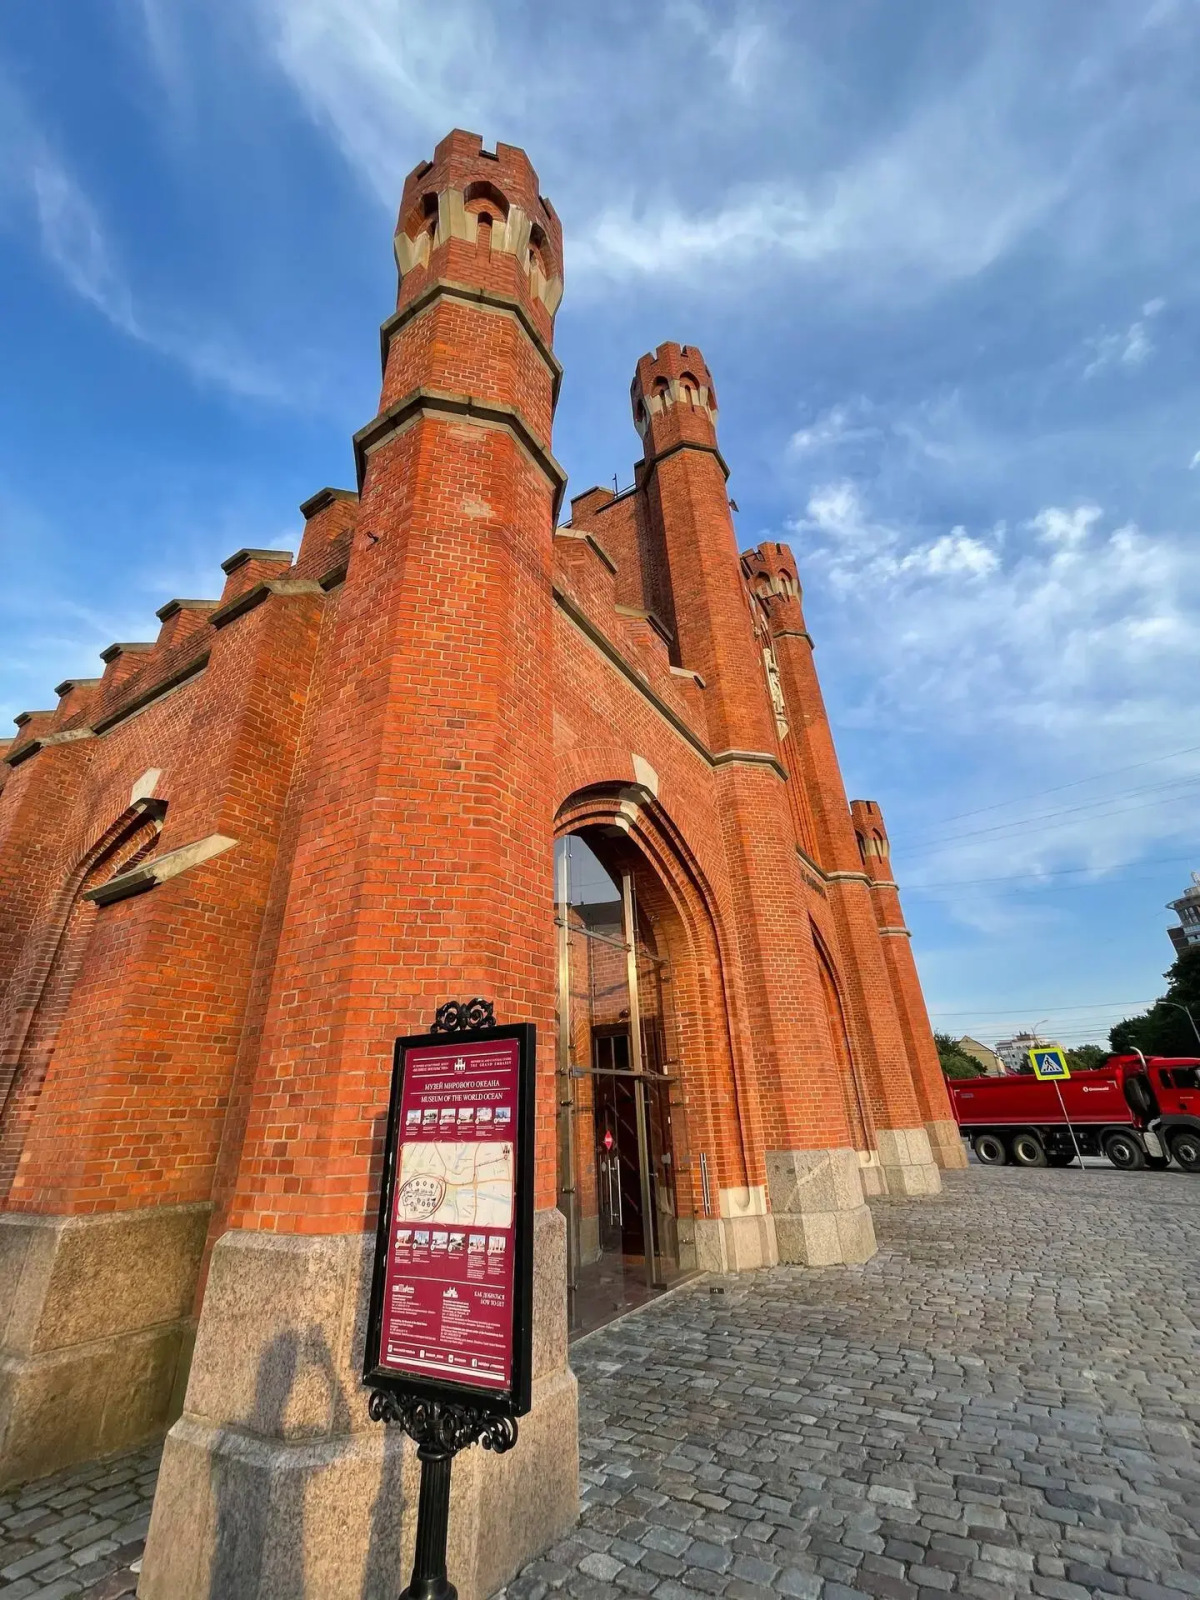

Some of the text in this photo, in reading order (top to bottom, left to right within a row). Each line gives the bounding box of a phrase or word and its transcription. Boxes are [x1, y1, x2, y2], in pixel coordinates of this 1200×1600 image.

[424, 1079, 500, 1091] МУЗЕЙ МИРОВОГО ОКЕАНА
[421, 1092, 503, 1103] MUSEUM OF THE WORLD OCEAN
